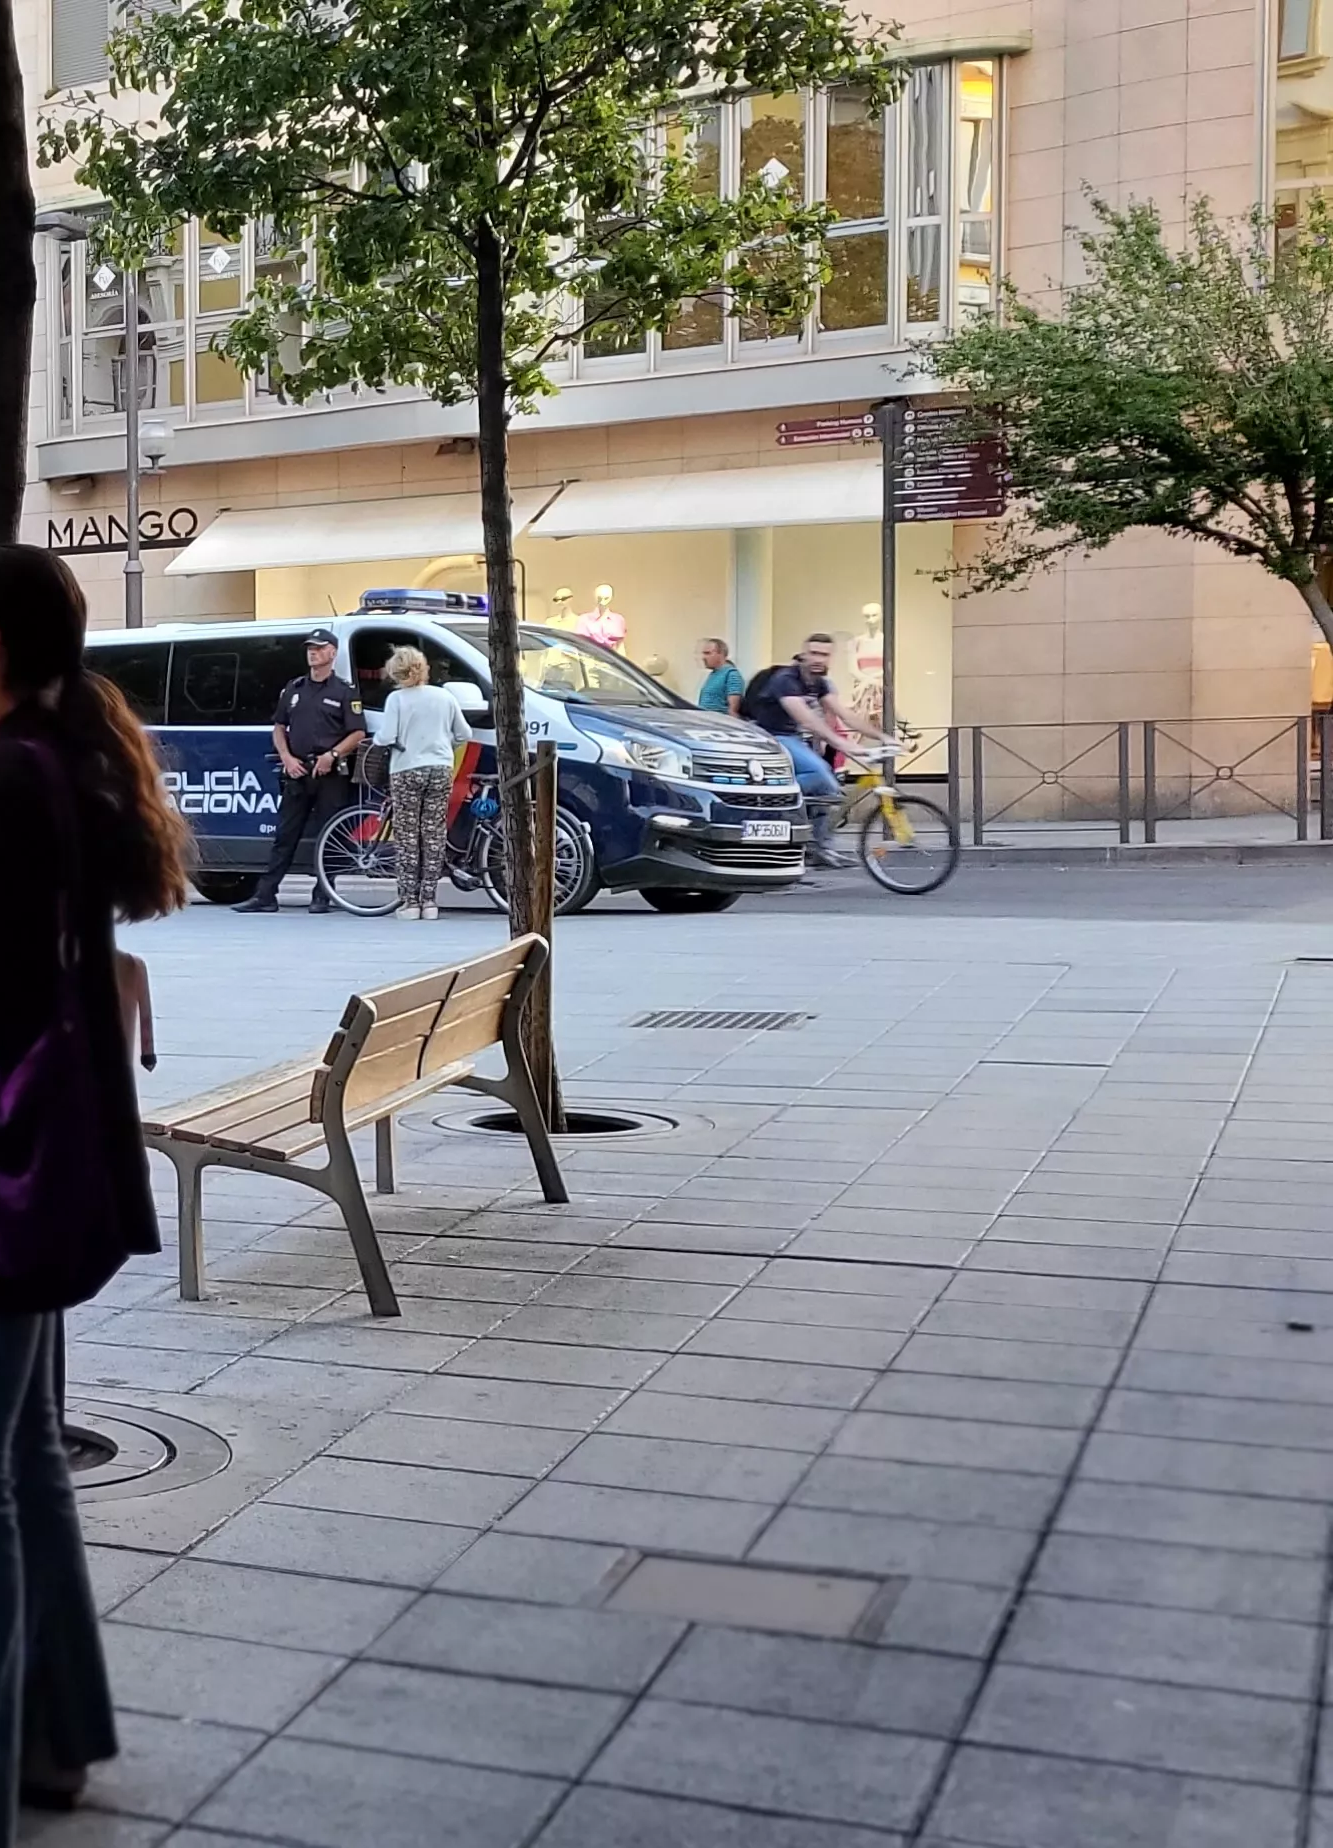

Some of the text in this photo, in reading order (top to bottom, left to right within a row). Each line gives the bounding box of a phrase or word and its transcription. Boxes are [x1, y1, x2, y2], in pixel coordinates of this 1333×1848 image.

[47, 507, 199, 549] MANGO
[157, 766, 262, 792] OLICÍA
[163, 792, 283, 814] ACIONA
